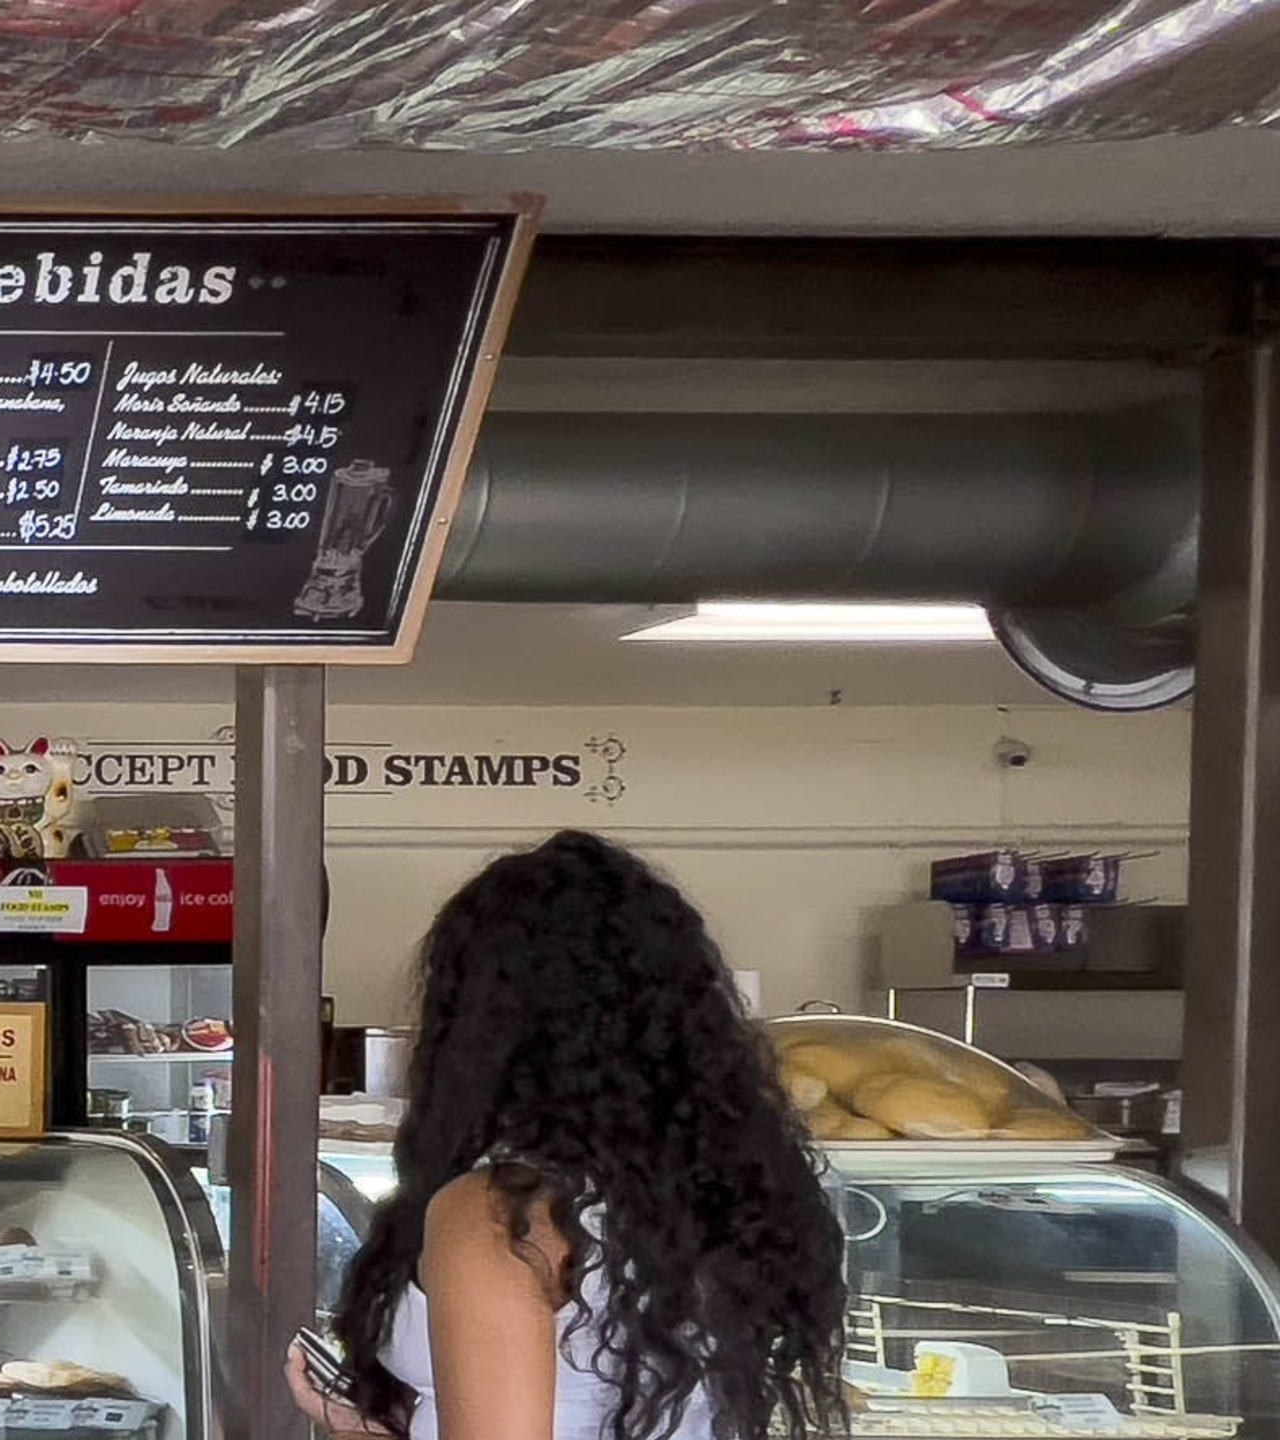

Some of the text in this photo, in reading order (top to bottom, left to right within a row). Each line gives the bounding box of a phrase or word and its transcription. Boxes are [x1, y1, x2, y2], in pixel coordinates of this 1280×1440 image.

[115, 360, 283, 393] Jugos Naturales:
[113, 393, 165, 413] Morir
[166, 393, 242, 413] Soñando
[106, 421, 253, 447] Naranja Natural
[101, 448, 188, 474] Maracuya
[99, 475, 189, 496] Tamarindo
[89, 501, 176, 523] Limonada
[383, 754, 582, 787] STAMPS
[98, 891, 206, 908] enjoy ice
